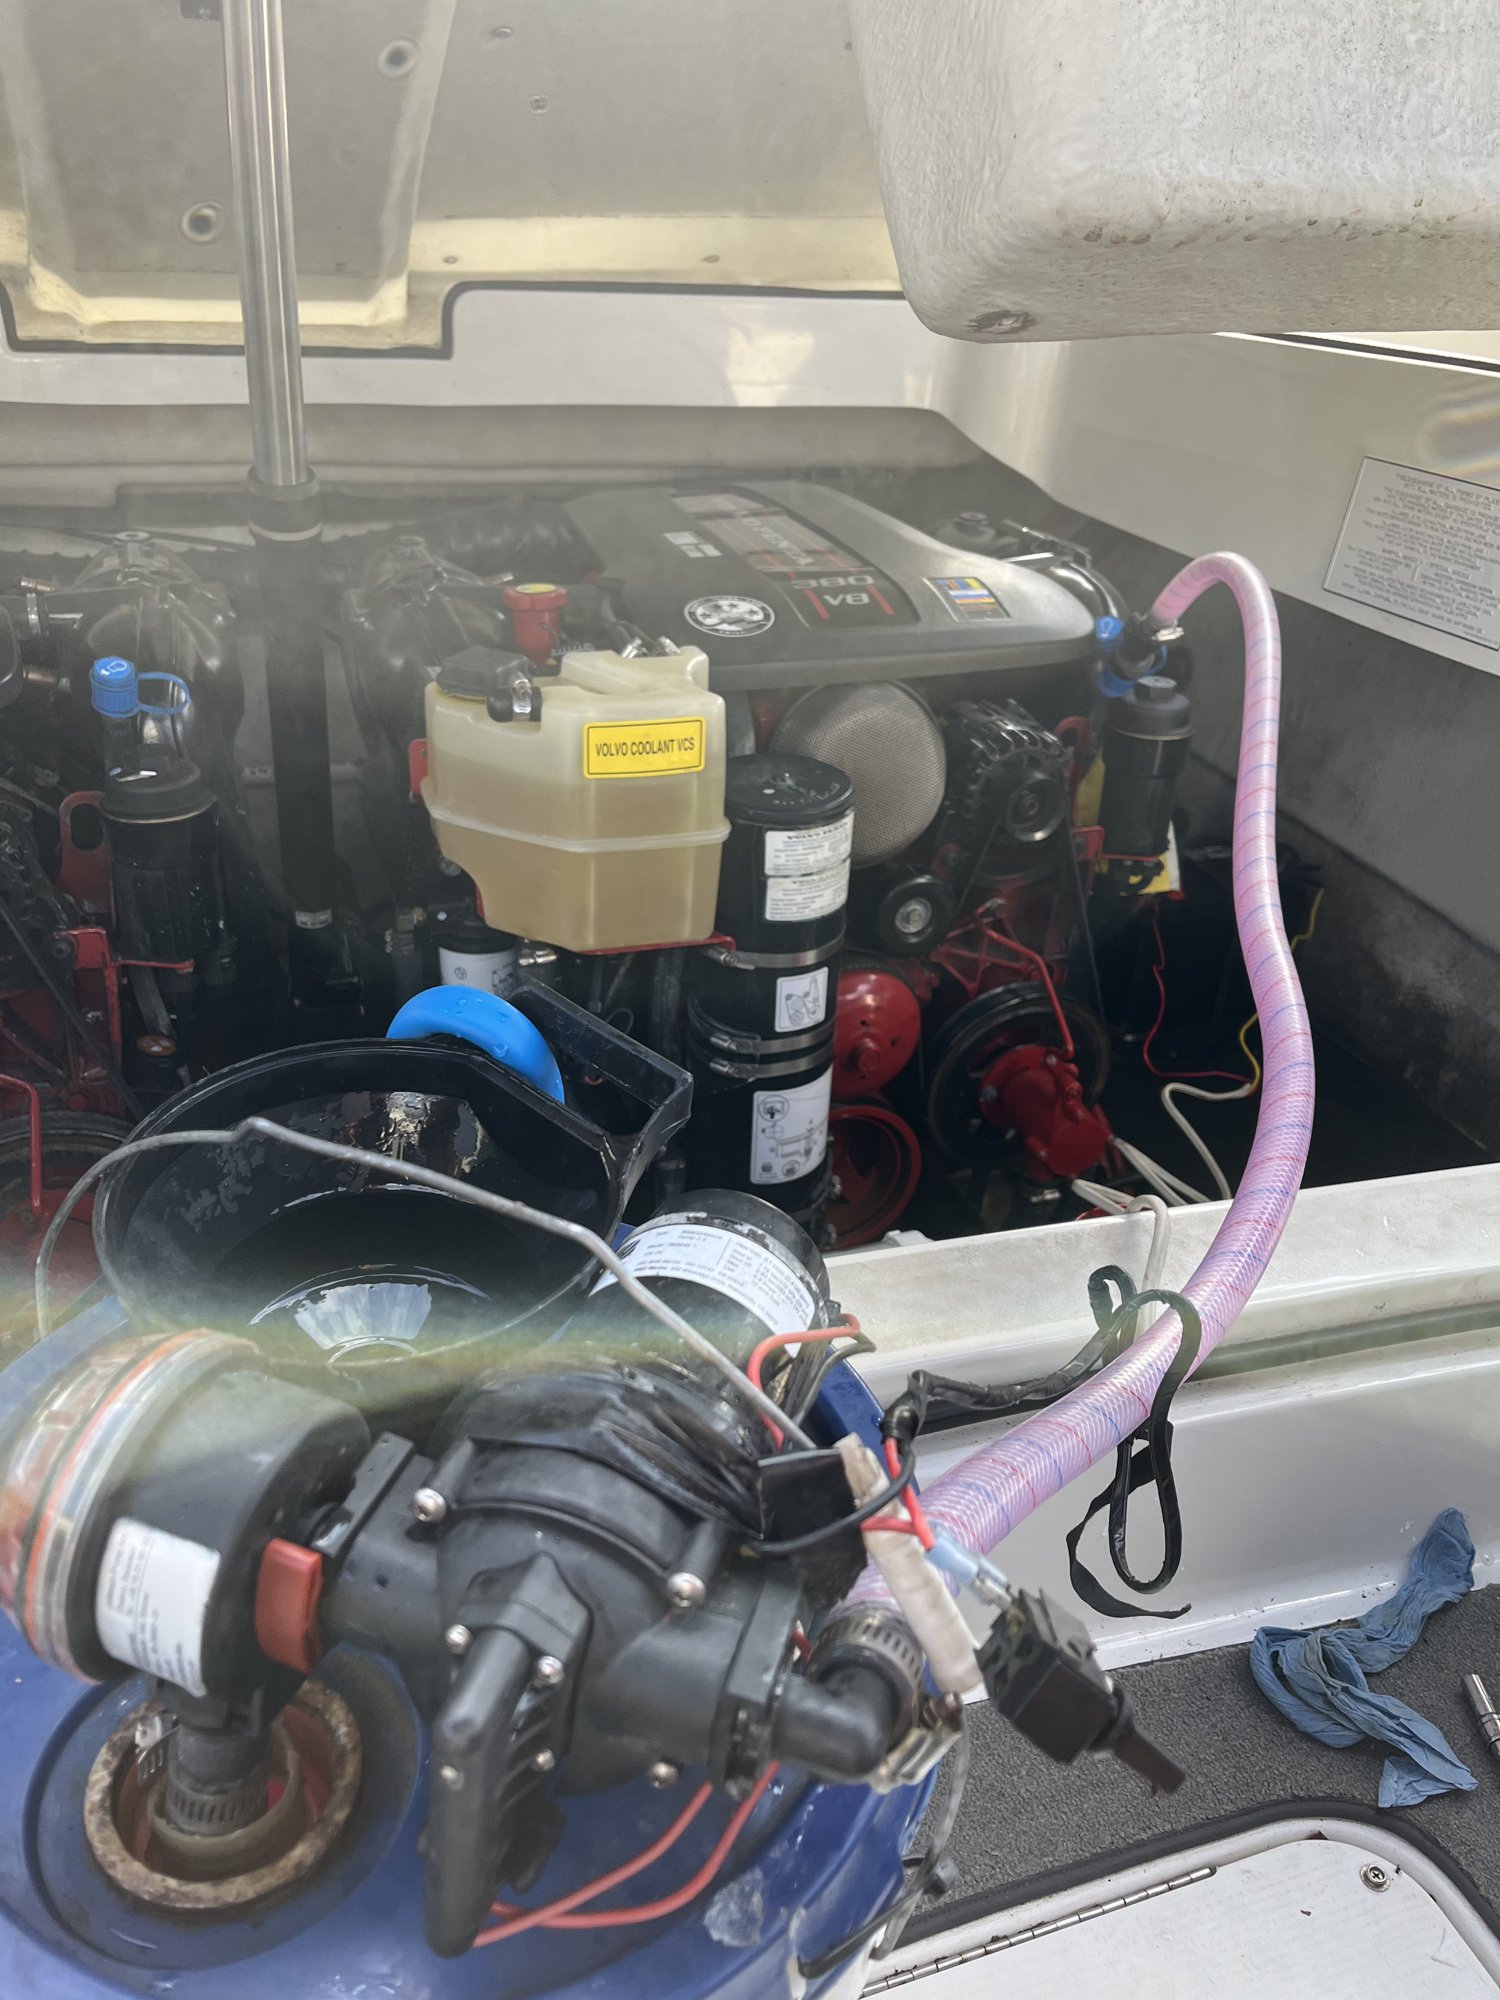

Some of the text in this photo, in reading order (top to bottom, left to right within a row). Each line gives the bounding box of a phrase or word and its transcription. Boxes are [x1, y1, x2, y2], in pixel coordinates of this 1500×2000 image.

[791, 575, 874, 589] 380
[823, 593, 870, 606] V8
[595, 736, 695, 757] VOLVO COOLANT VCS
